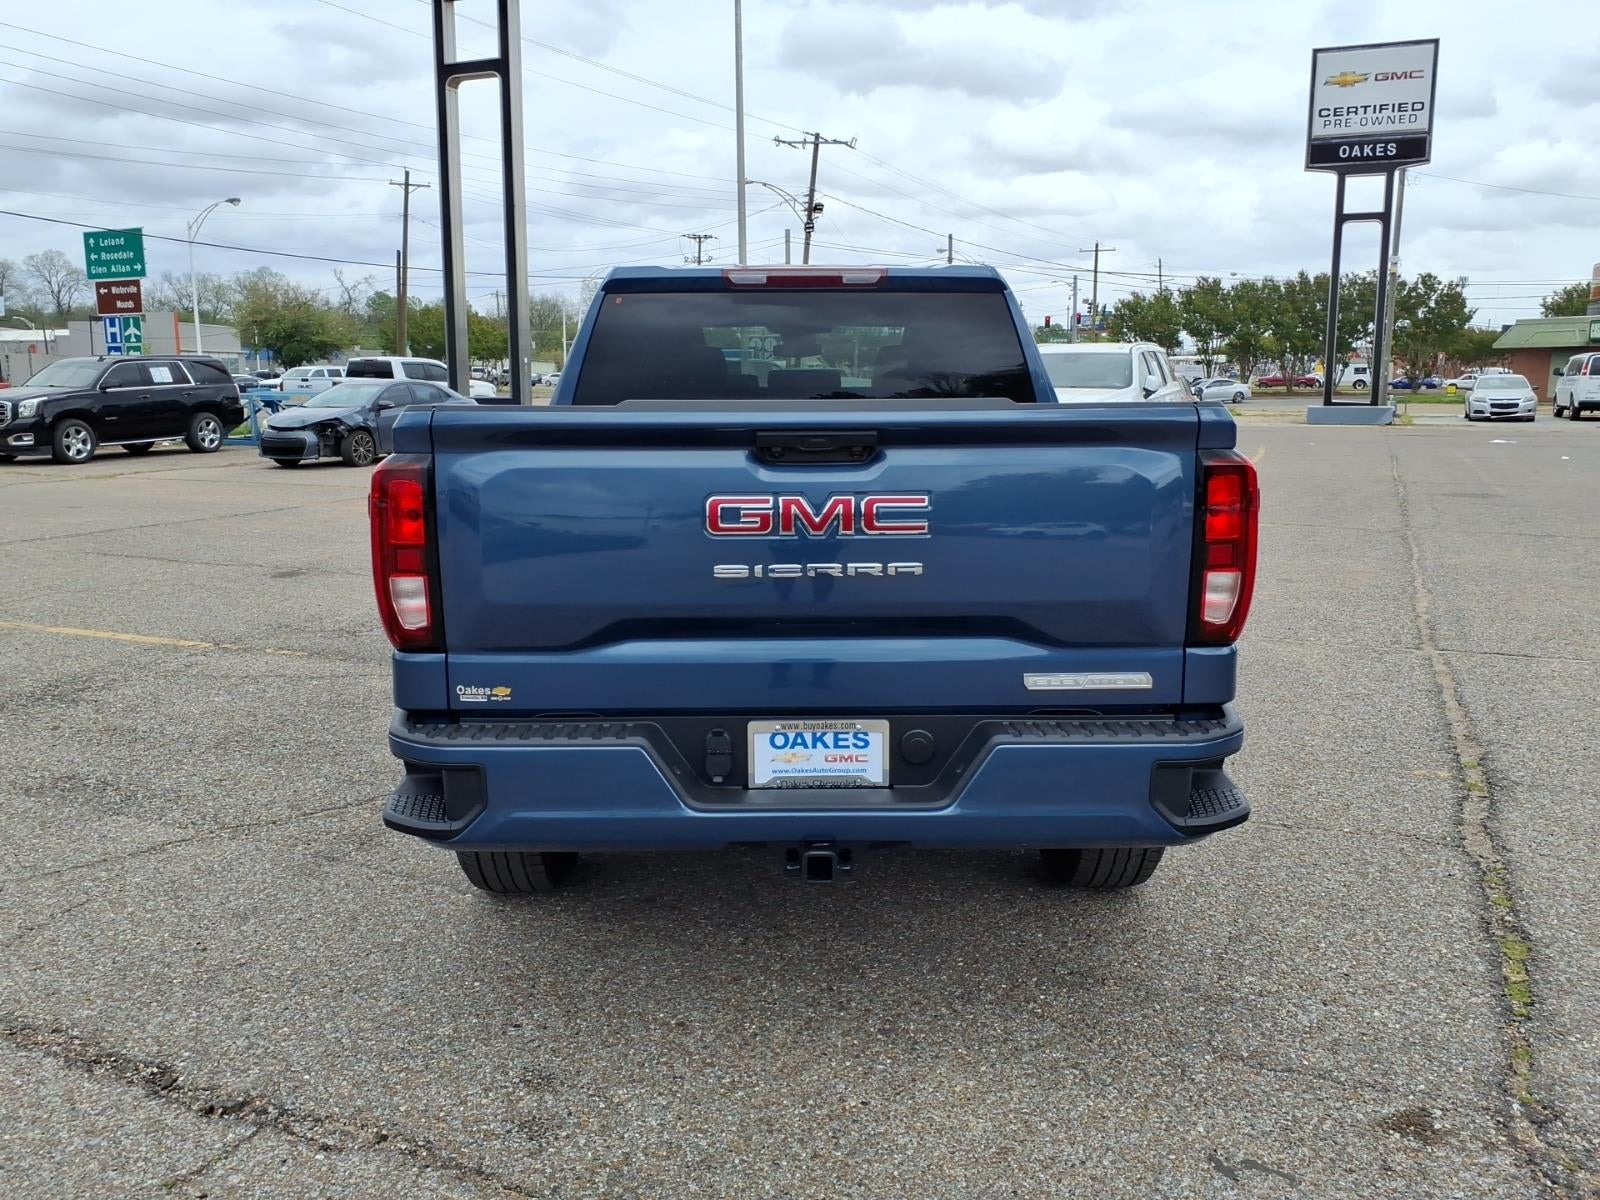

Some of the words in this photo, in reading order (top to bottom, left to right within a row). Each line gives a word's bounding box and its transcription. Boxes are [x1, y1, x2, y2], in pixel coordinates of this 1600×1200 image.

[1374, 70, 1425, 82] GMC
[1318, 101, 1425, 118] CERTIFIED
[1323, 114, 1418, 129] PRE-OWNED
[1339, 143, 1397, 158] OAKES
[99, 236, 125, 247] Leland
[100, 251, 134, 260] Rosedale
[91, 265, 108, 274] Glen
[110, 264, 131, 273] Allan
[105, 318, 121, 343] H
[705, 495, 930, 536] GMC
[713, 562, 924, 578] SIERRA
[456, 685, 491, 695] Oakes
[780, 721, 857, 731] www.buyoakes.com
[769, 732, 870, 750] OAKES
[824, 754, 869, 763] GMC
[771, 767, 867, 775] www.OakesAutoGroup.com
